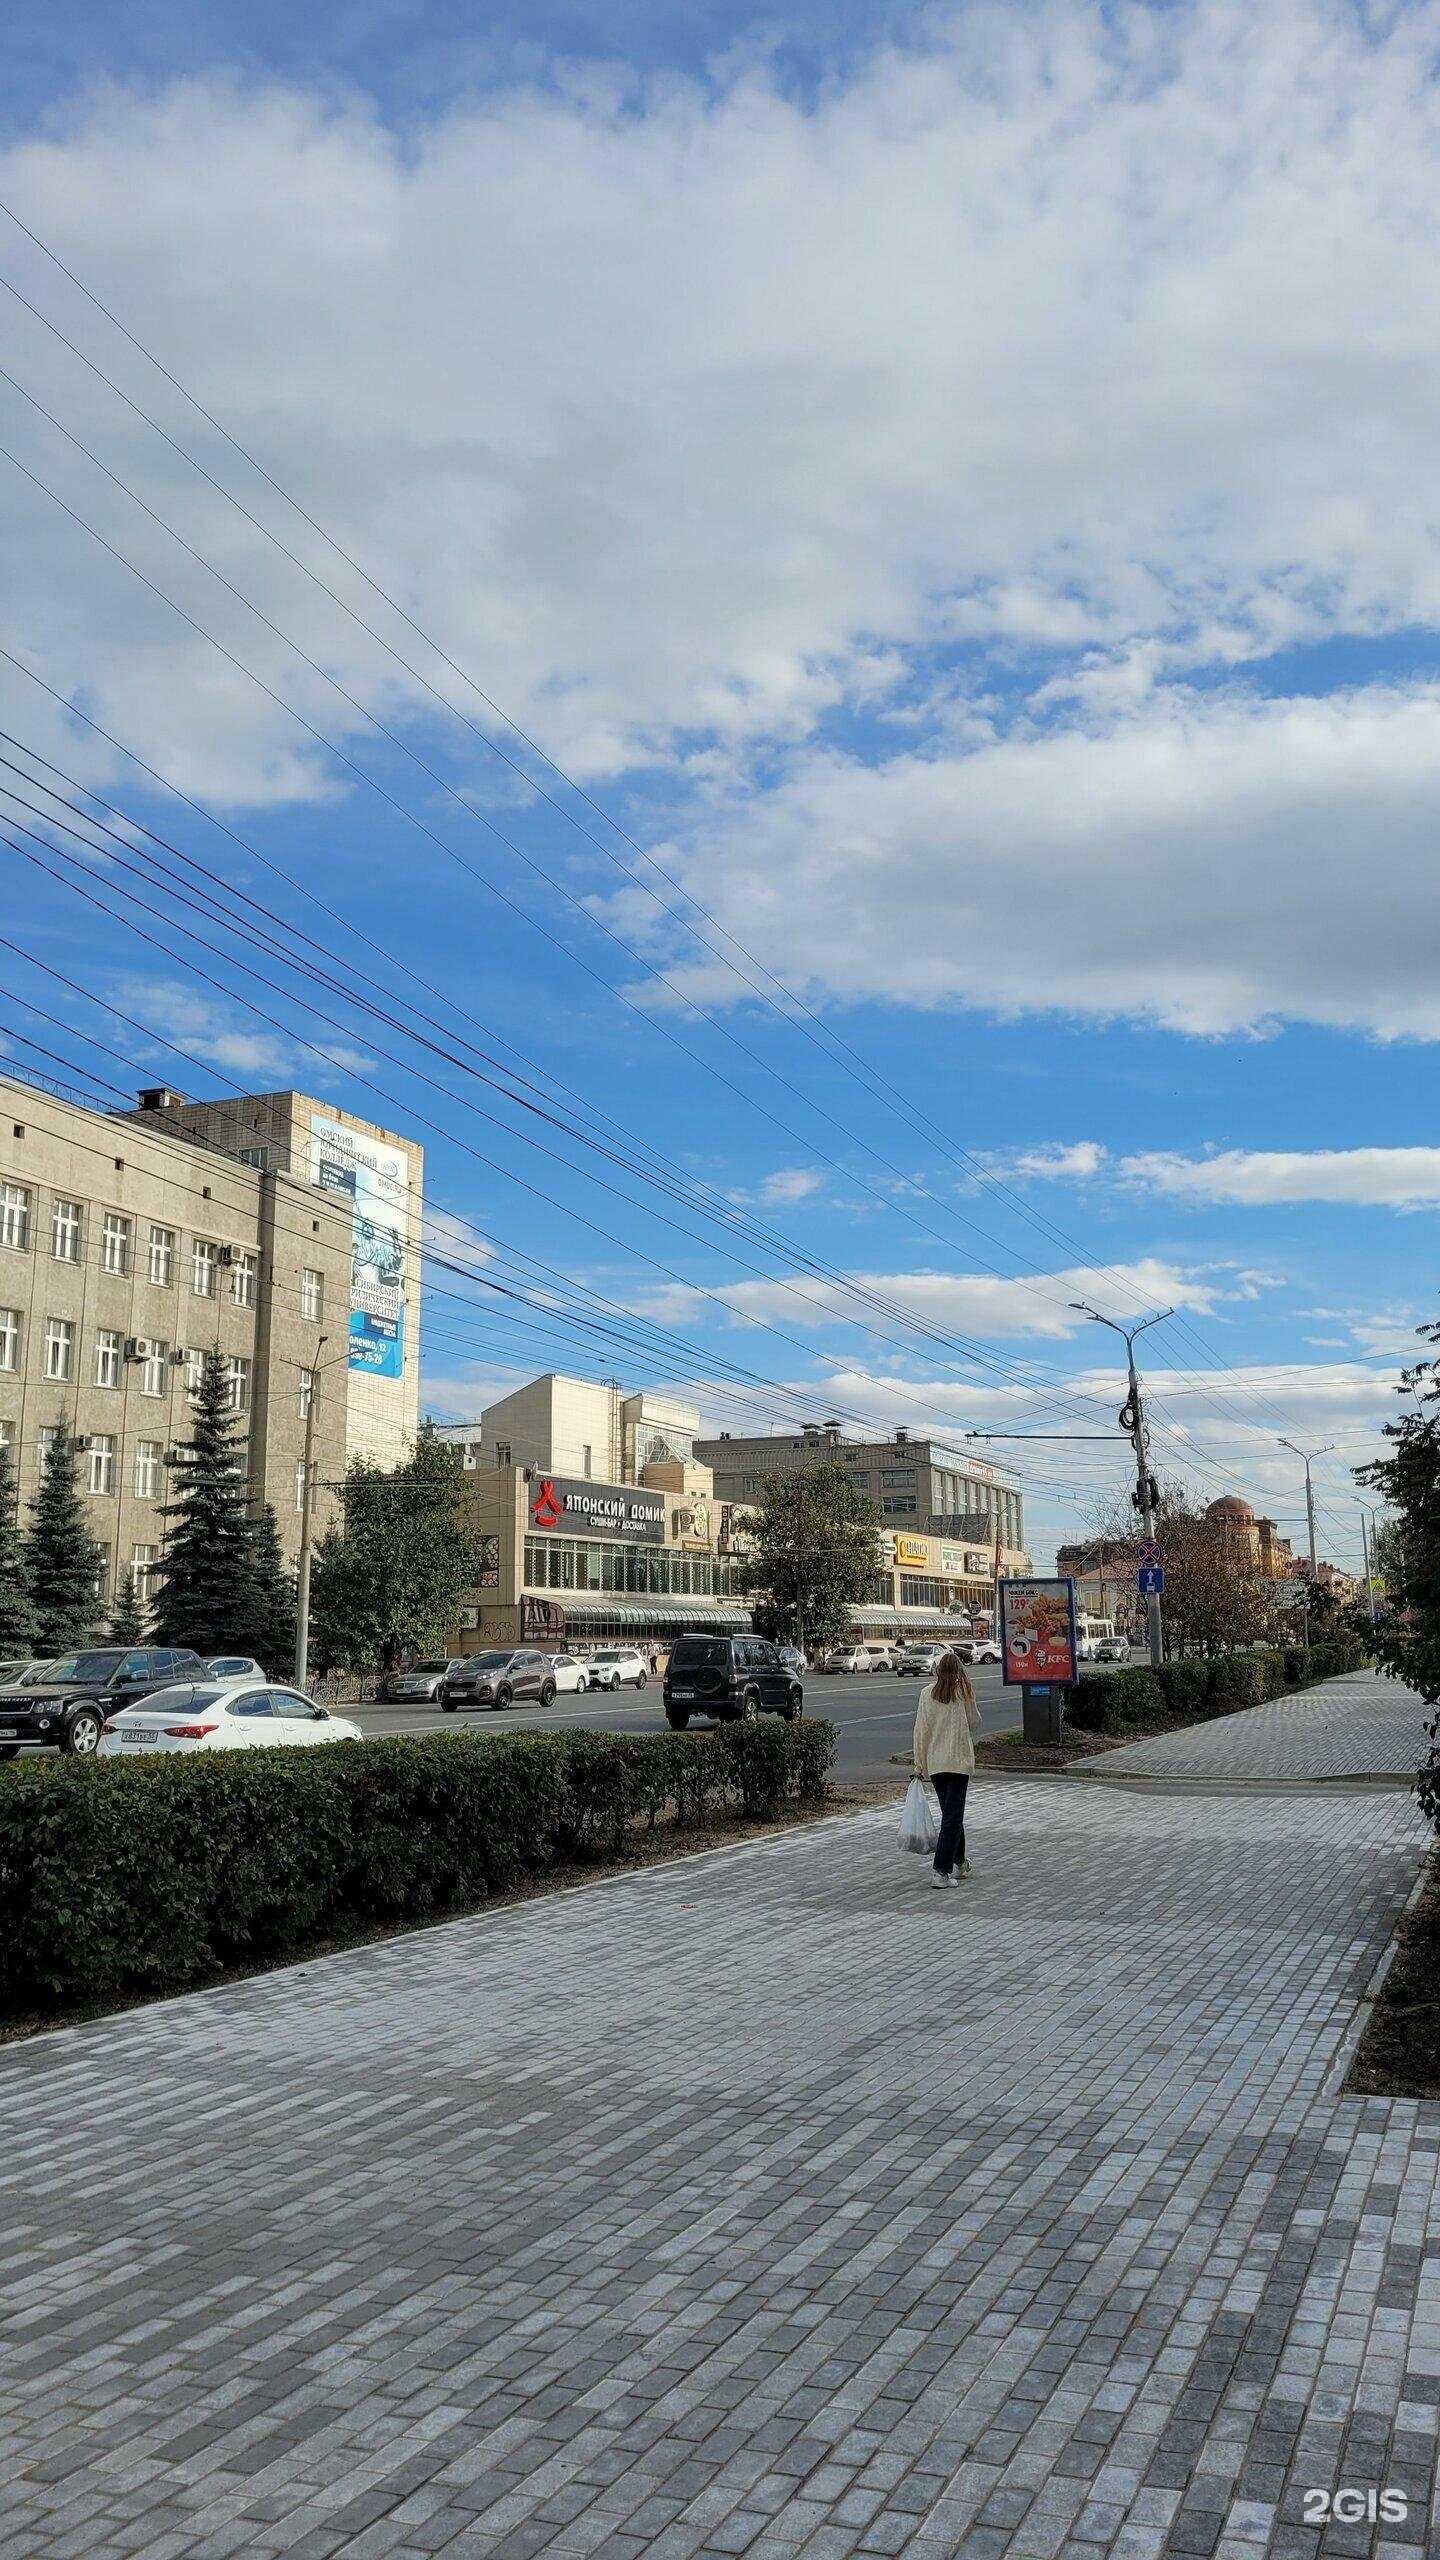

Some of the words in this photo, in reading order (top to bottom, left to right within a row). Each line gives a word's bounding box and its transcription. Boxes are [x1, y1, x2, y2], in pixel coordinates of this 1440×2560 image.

[349, 1335, 377, 1351] оленко,
[566, 1494, 626, 1517] ЯПОНСКИЙ
[631, 1504, 666, 1522] ДОМИК
[1047, 1654, 1070, 1664] KFC
